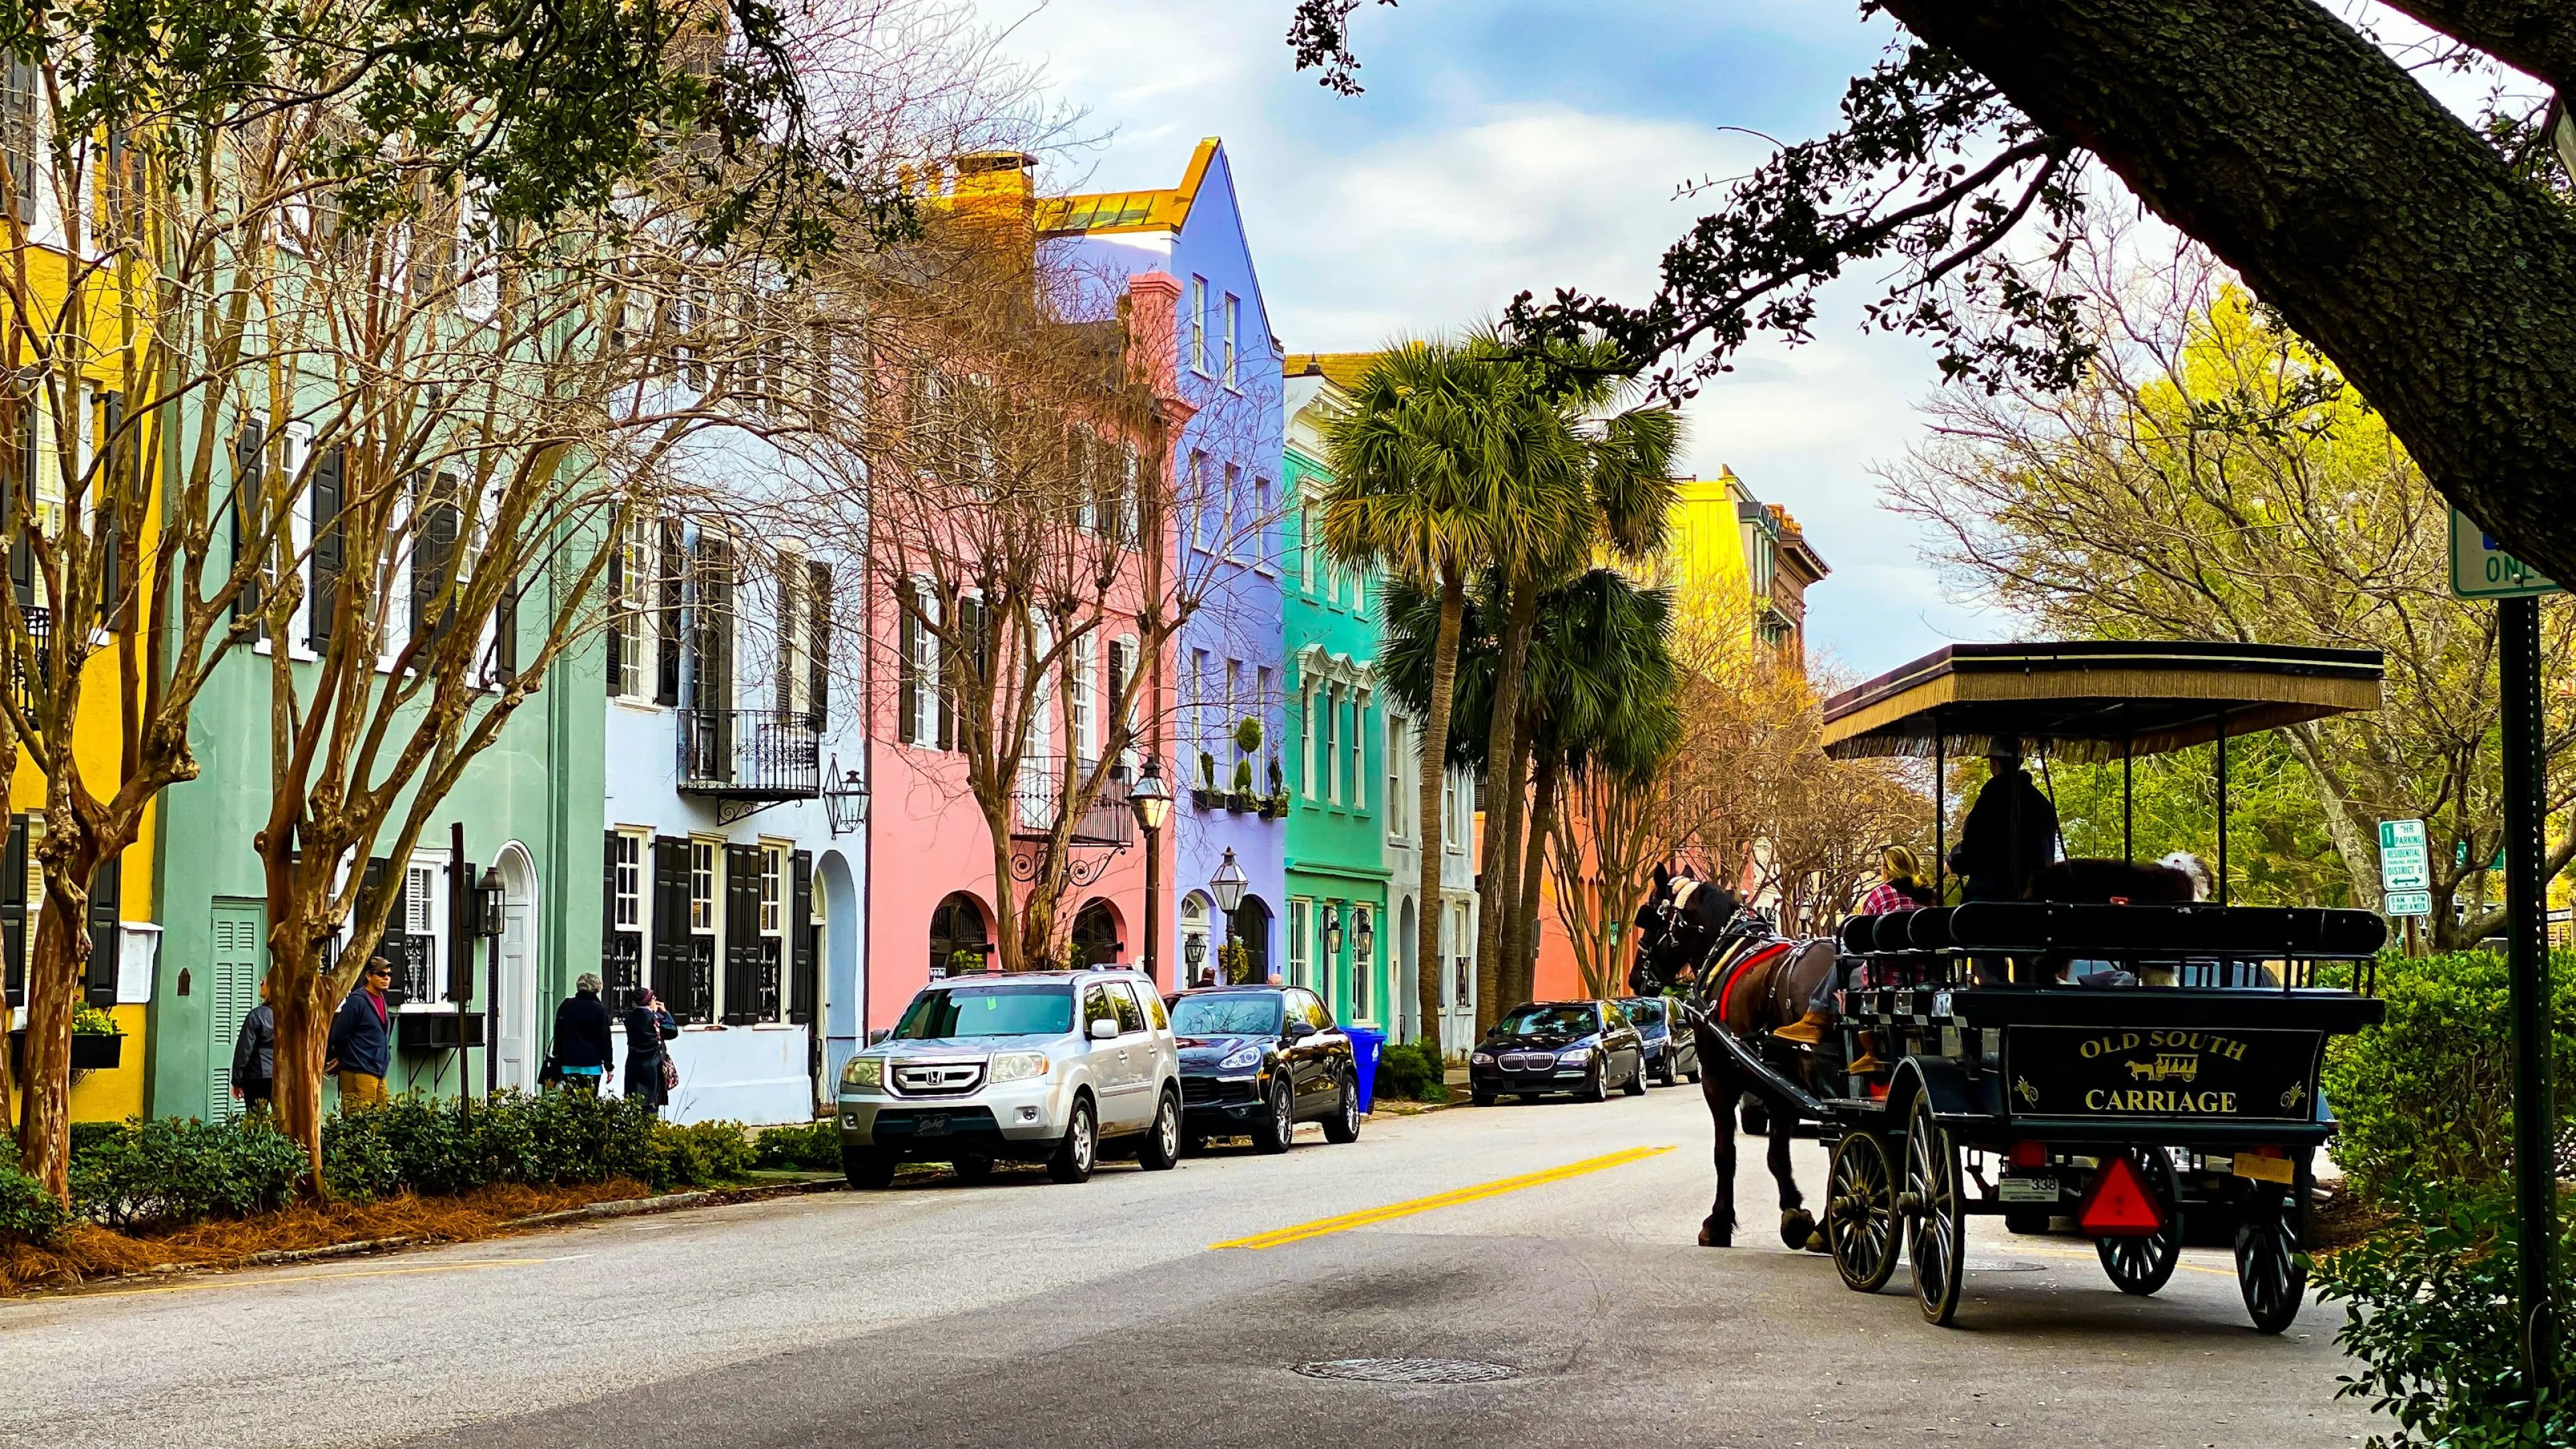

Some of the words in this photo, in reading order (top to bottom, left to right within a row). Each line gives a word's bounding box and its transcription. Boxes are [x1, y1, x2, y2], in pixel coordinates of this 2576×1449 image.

[2486, 555, 2546, 582] ONL
[2385, 828, 2391, 845] 1
[2396, 836, 2422, 845] PARKING
[2387, 849, 2421, 859] RESIDENTIAL
[2388, 866, 2415, 875] DISTRICT
[2080, 1033, 2140, 1059] OLD
[2149, 1030, 2247, 1061] SOUTH
[2085, 1089, 2237, 1112] CARRIAGE
[2032, 1179, 2057, 1190] 338
